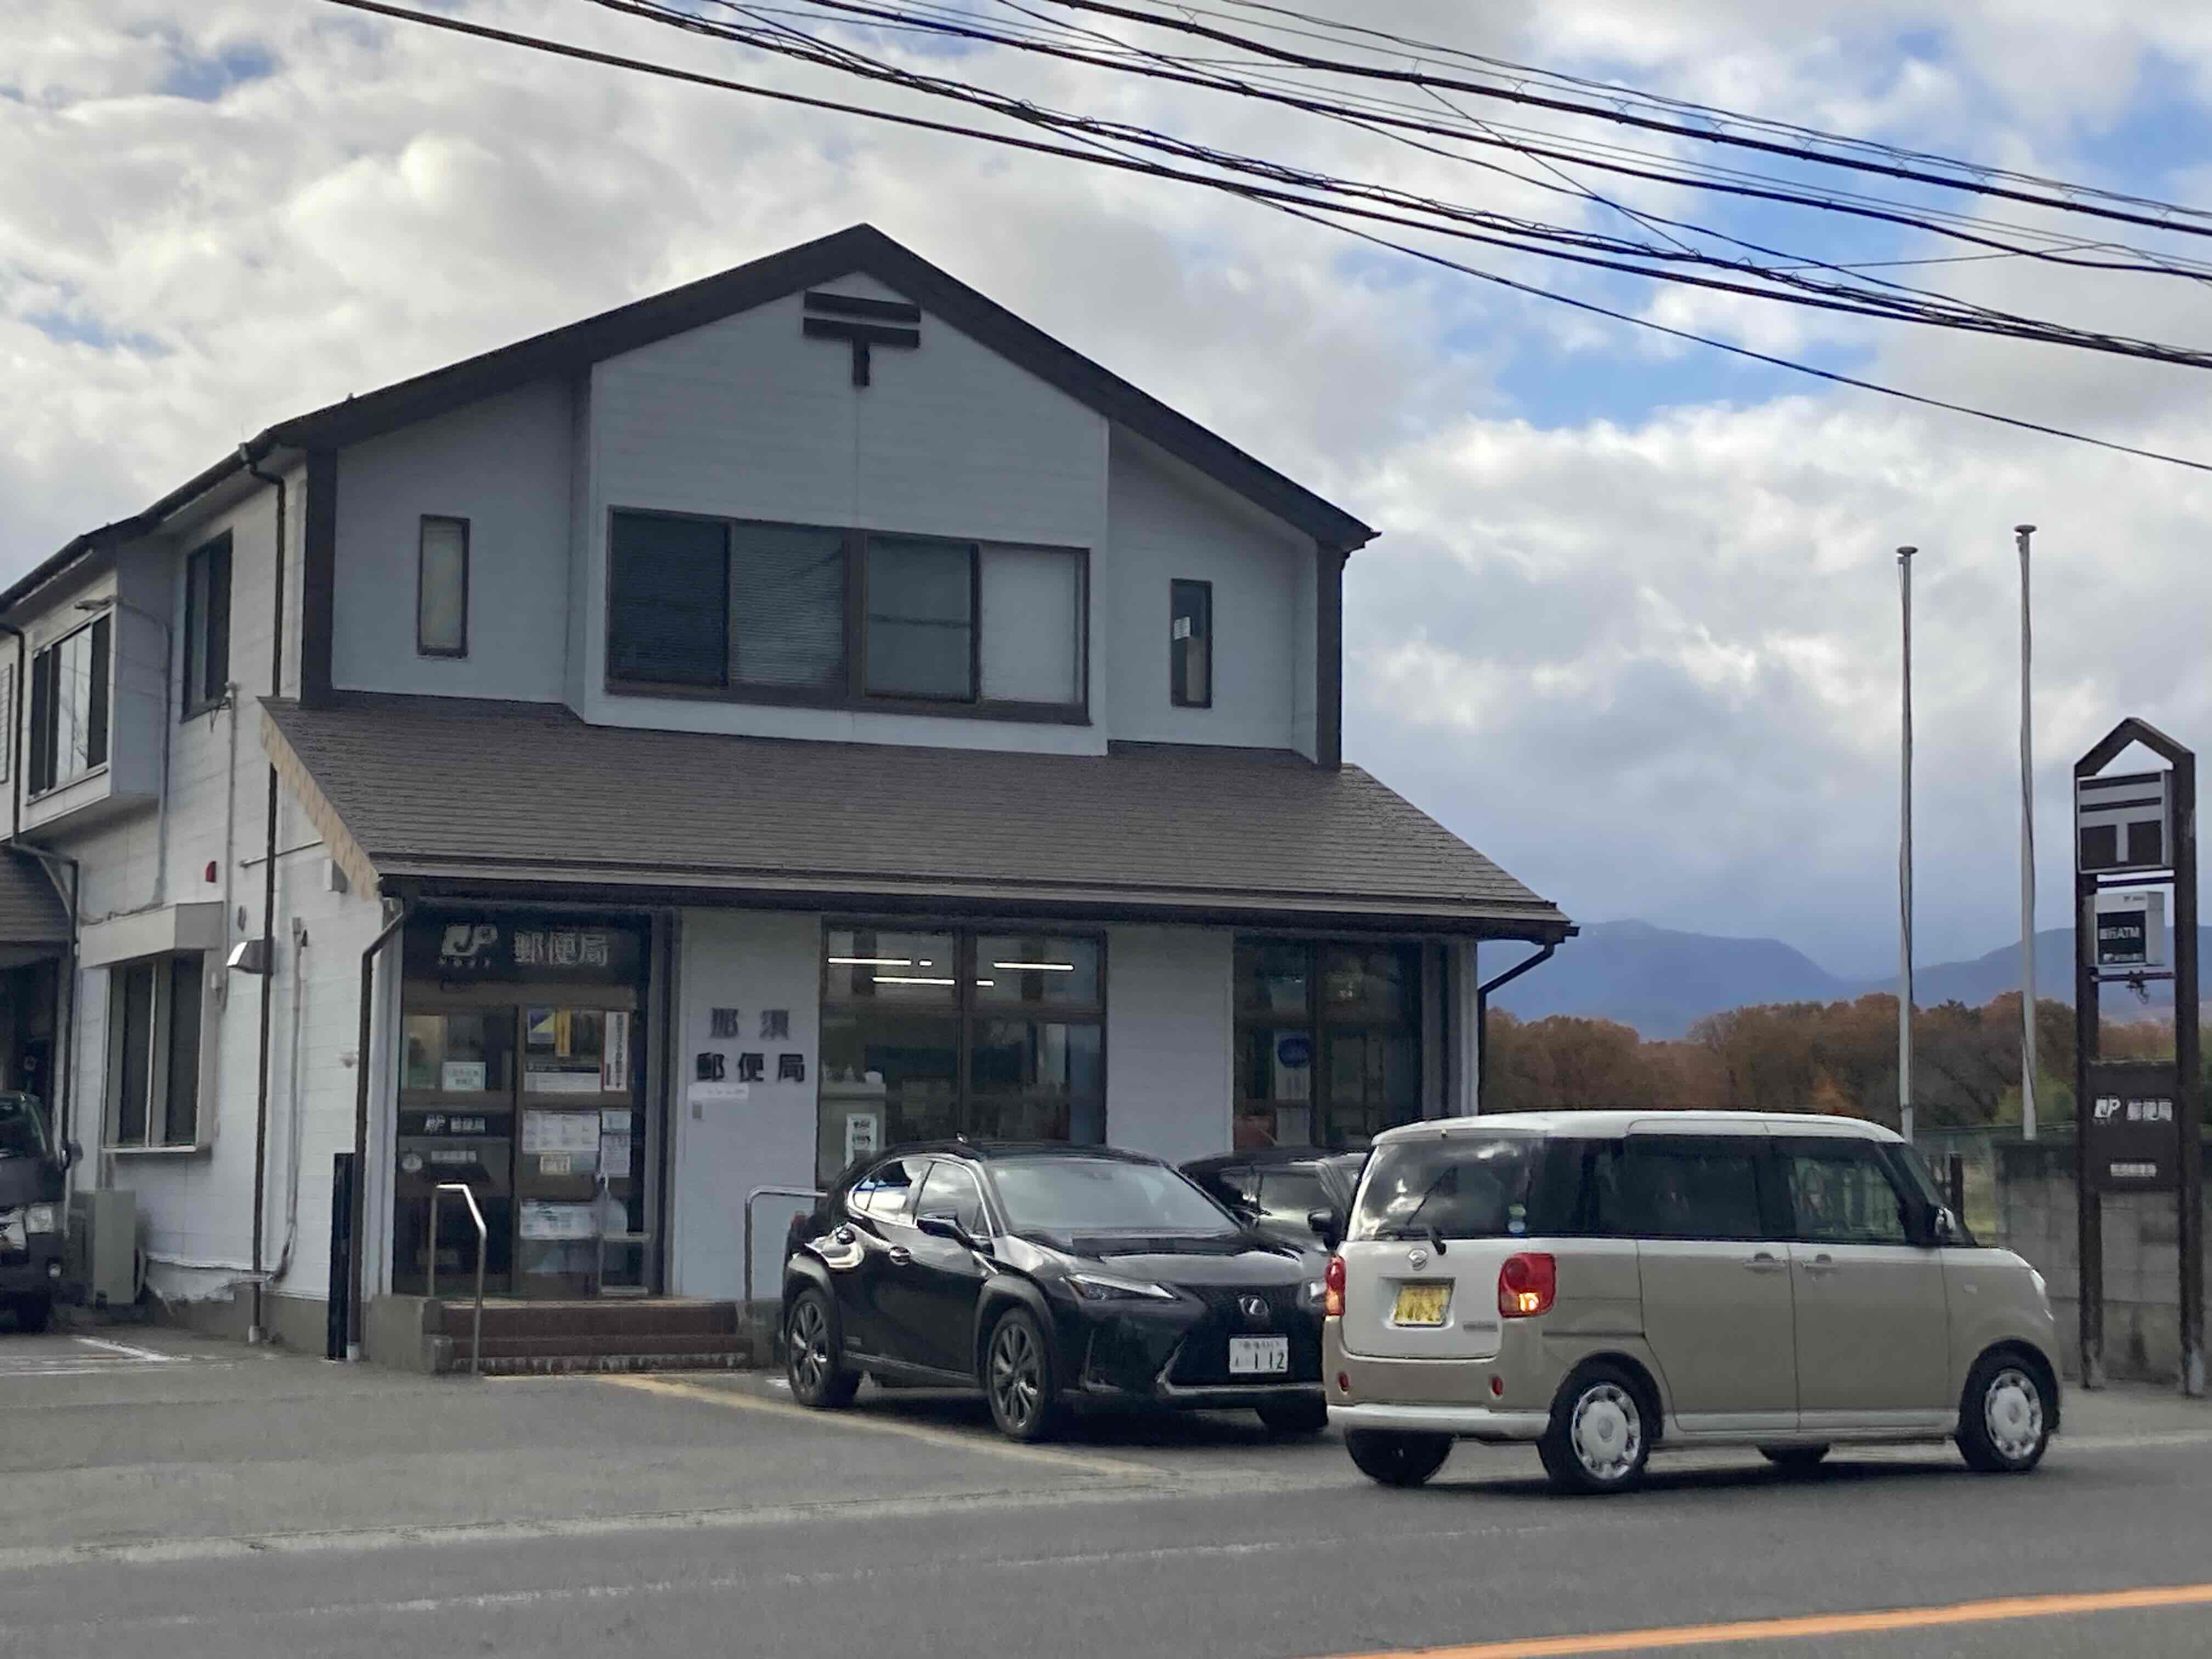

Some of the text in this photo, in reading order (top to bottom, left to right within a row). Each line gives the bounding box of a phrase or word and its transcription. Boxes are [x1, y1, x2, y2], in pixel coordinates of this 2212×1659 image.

[441, 924, 610, 966] JP 郵便局
[696, 1052, 805, 1082] 郵便局
[2094, 1096, 2121, 1119] JP
